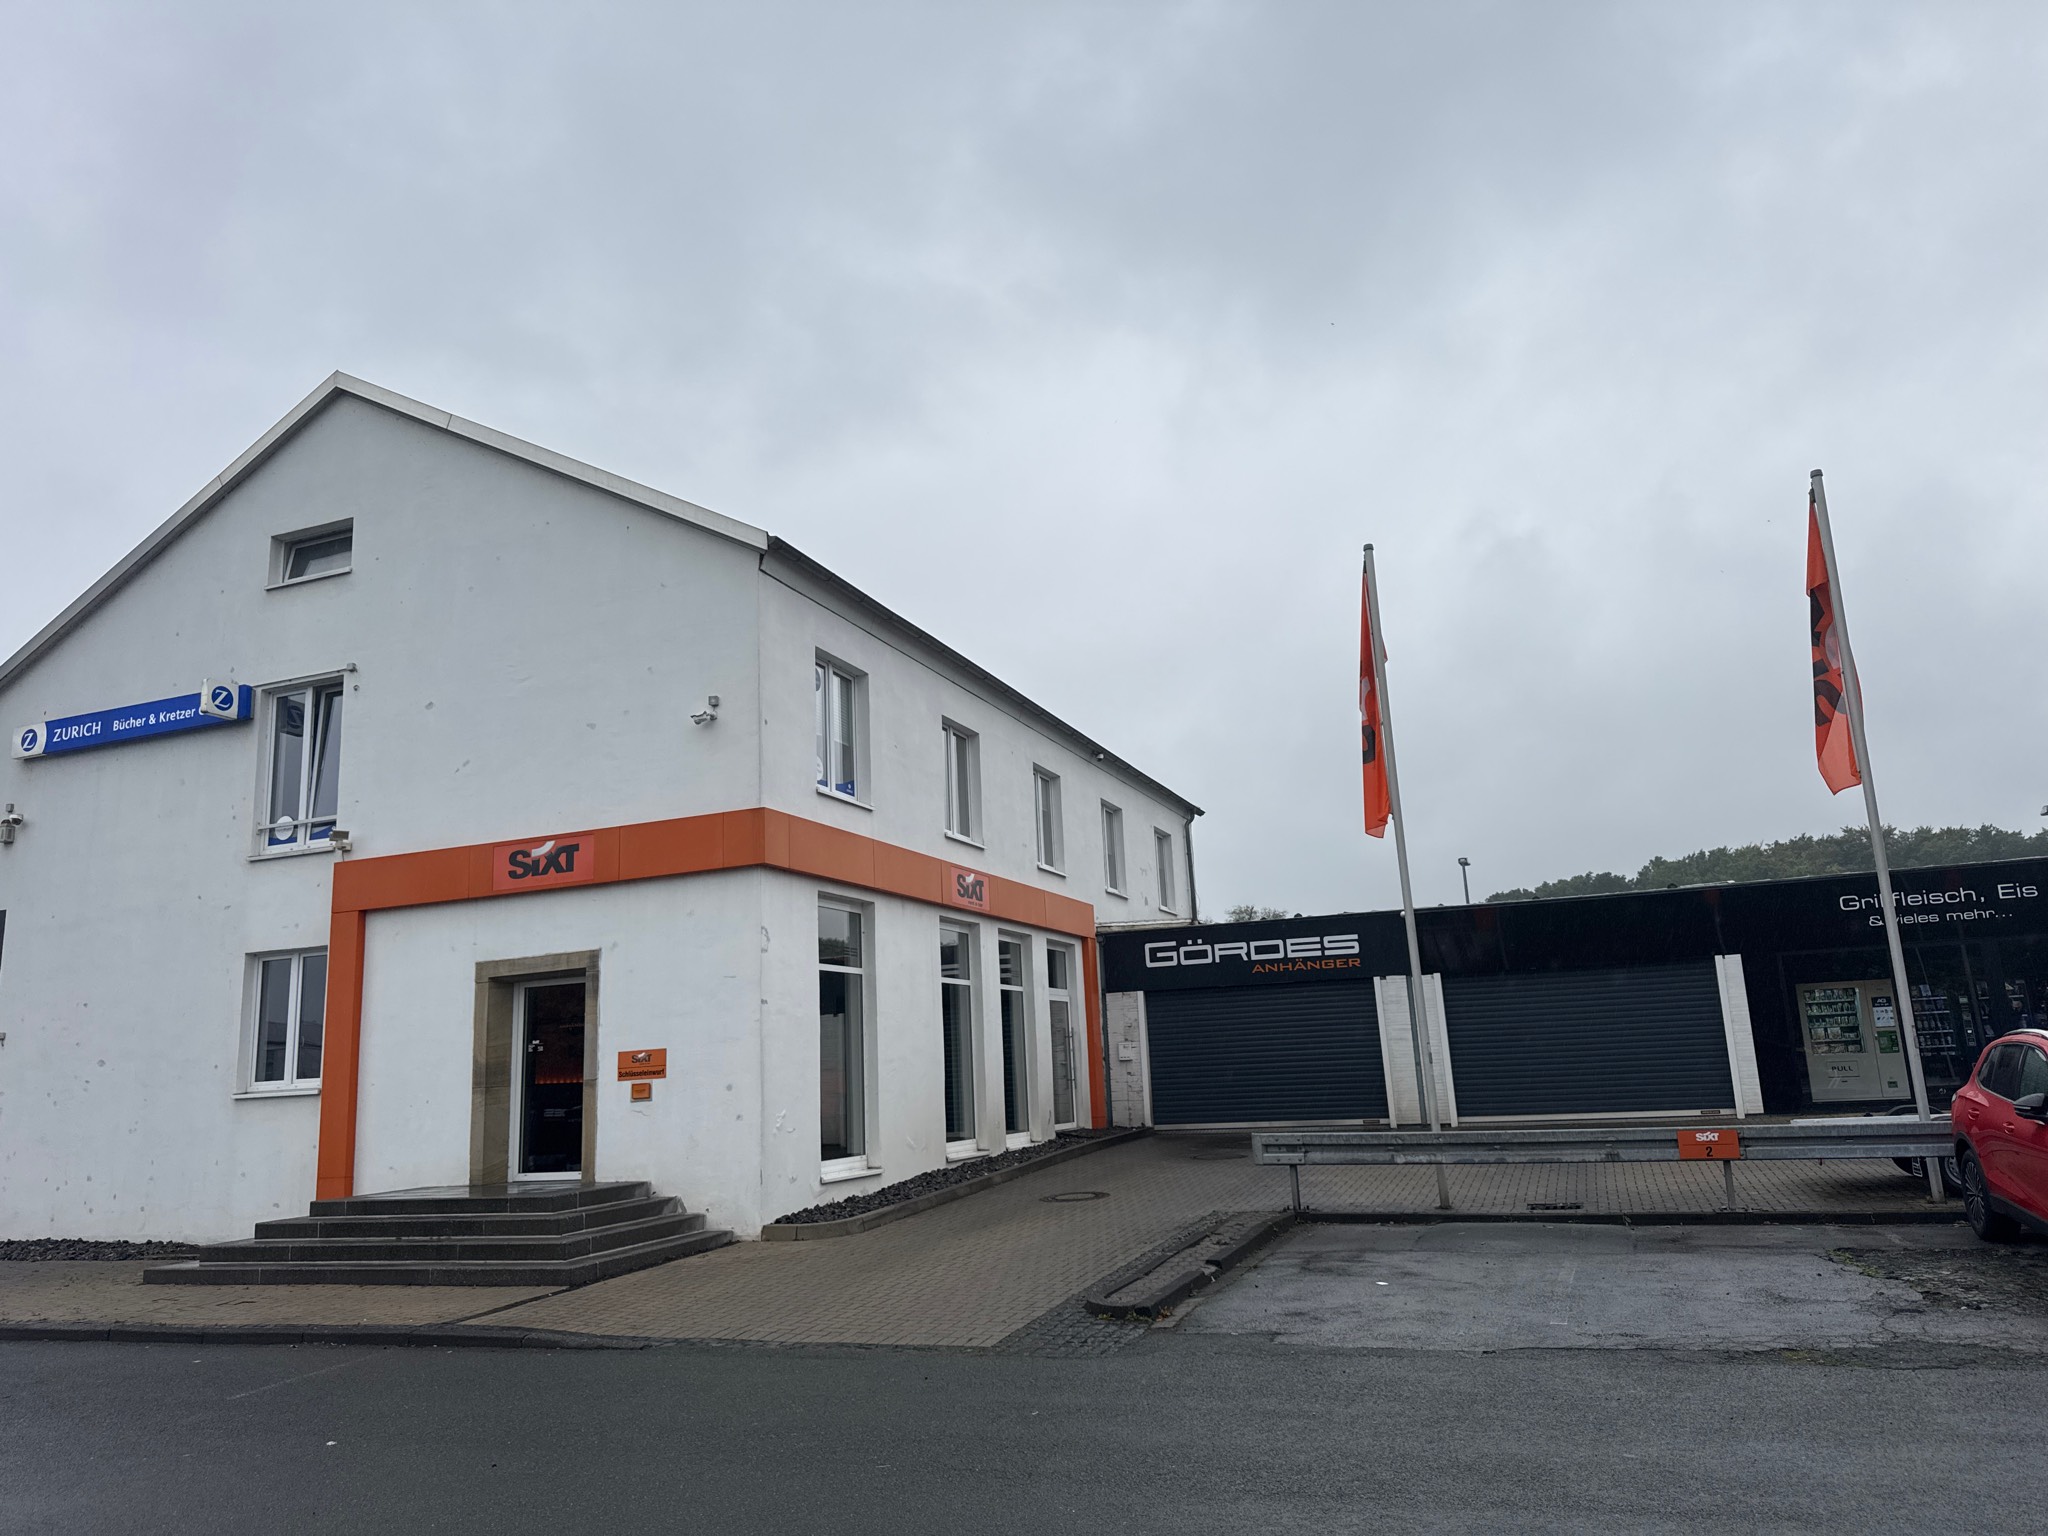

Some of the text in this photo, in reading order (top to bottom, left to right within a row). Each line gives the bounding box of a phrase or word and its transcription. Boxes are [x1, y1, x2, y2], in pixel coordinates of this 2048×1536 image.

[53, 721, 102, 742] ZURICH
[113, 717, 146, 731] Bücher
[149, 714, 156, 724] &
[159, 707, 195, 723] Kretzer
[1839, 882, 2039, 911] Grilfleisch, Eis
[1868, 915, 1884, 927] &
[1144, 934, 1360, 968] GÖRDES
[1252, 958, 1361, 974] ANHÄNGER
[1706, 1146, 1713, 1157] 2
